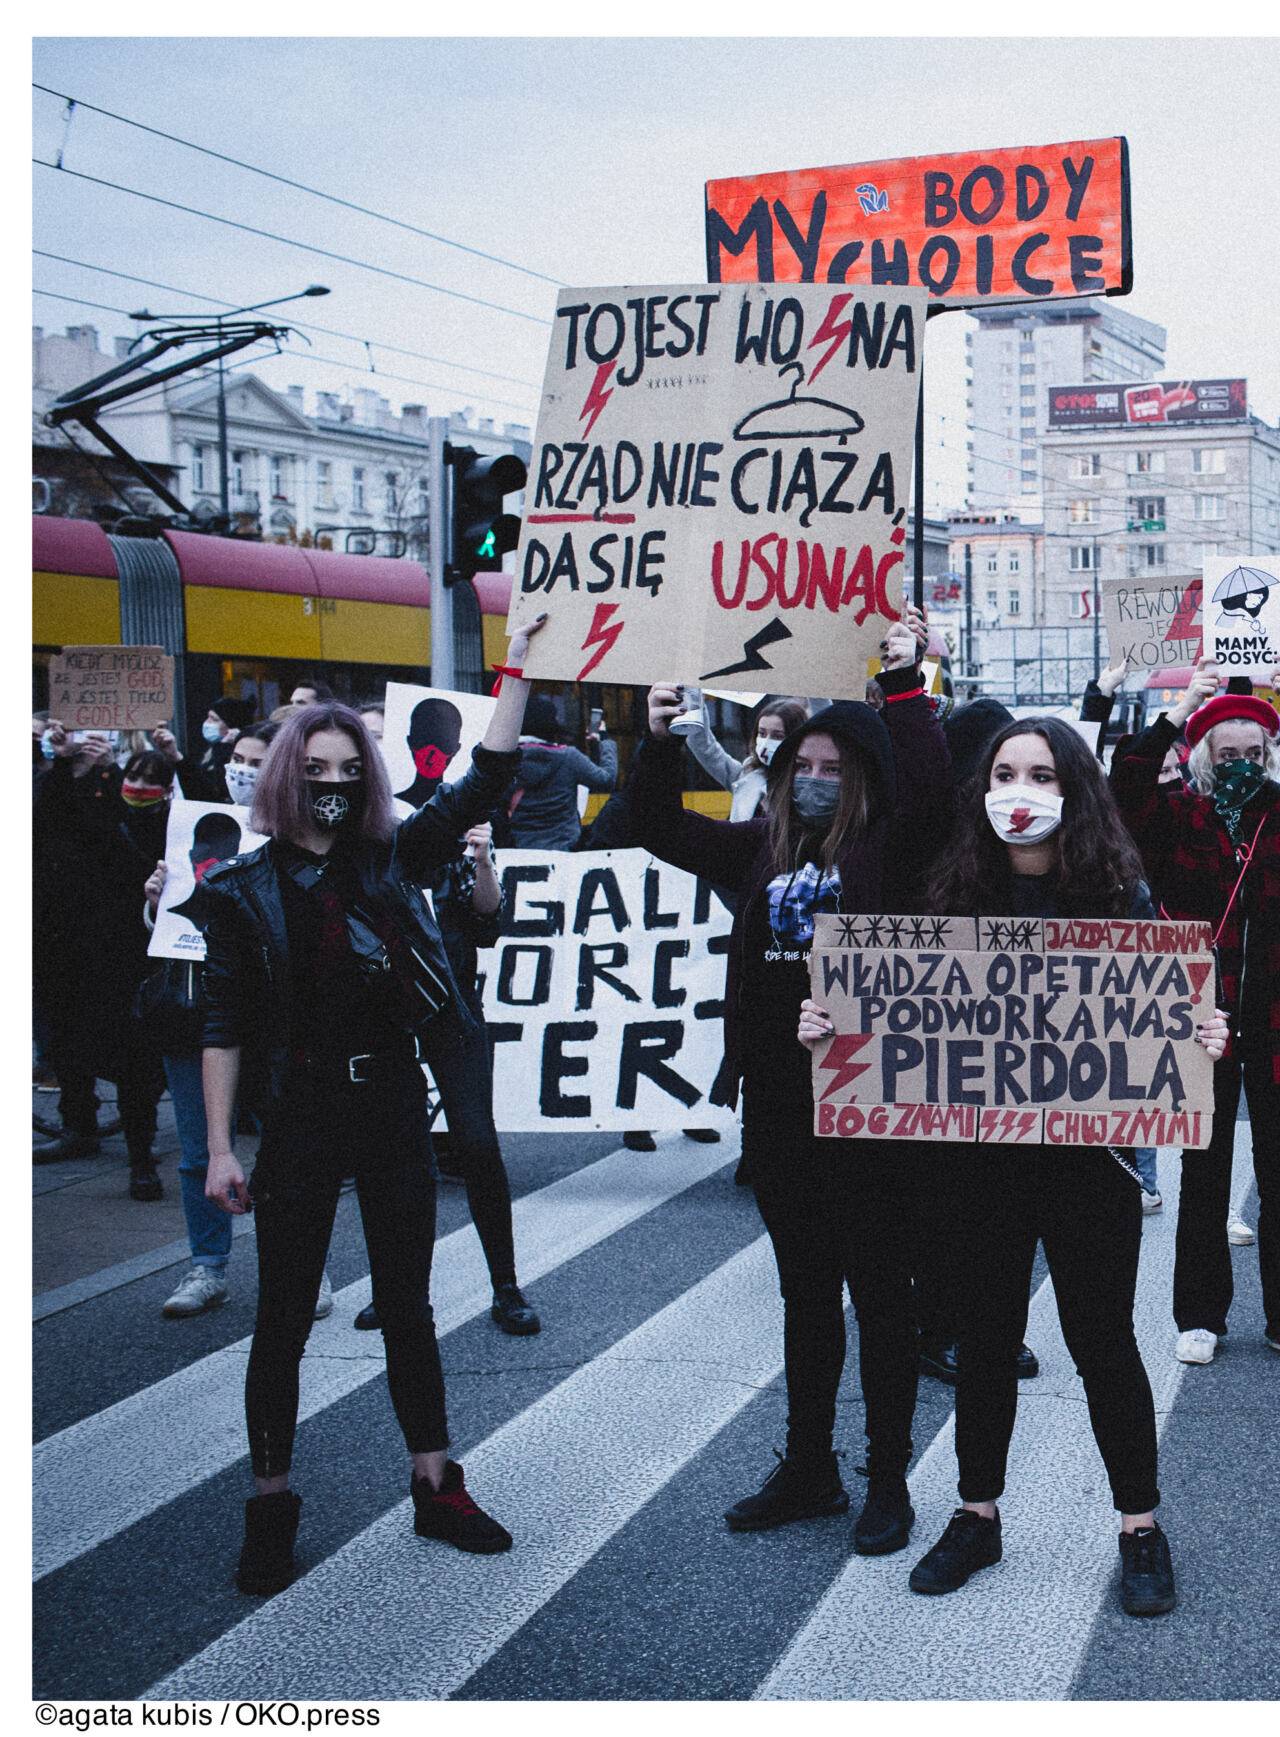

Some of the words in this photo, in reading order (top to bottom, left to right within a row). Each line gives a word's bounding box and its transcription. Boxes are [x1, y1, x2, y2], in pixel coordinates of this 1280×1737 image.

[707, 190, 826, 283] MY
[924, 156, 1095, 227] BODY
[827, 232, 1106, 296] CHOICE
[711, 527, 904, 626] USUNĄĆ
[1122, 639, 1203, 666] KOBIE
[1215, 636, 1269, 651] MAMY
[783, 951, 800, 961] THE
[822, 953, 973, 997] WŁADZA
[881, 1034, 1187, 1111] PIERDOLĄ
[818, 1095, 889, 1136] BÓG
[1046, 1111, 1107, 1144] CHUJ
